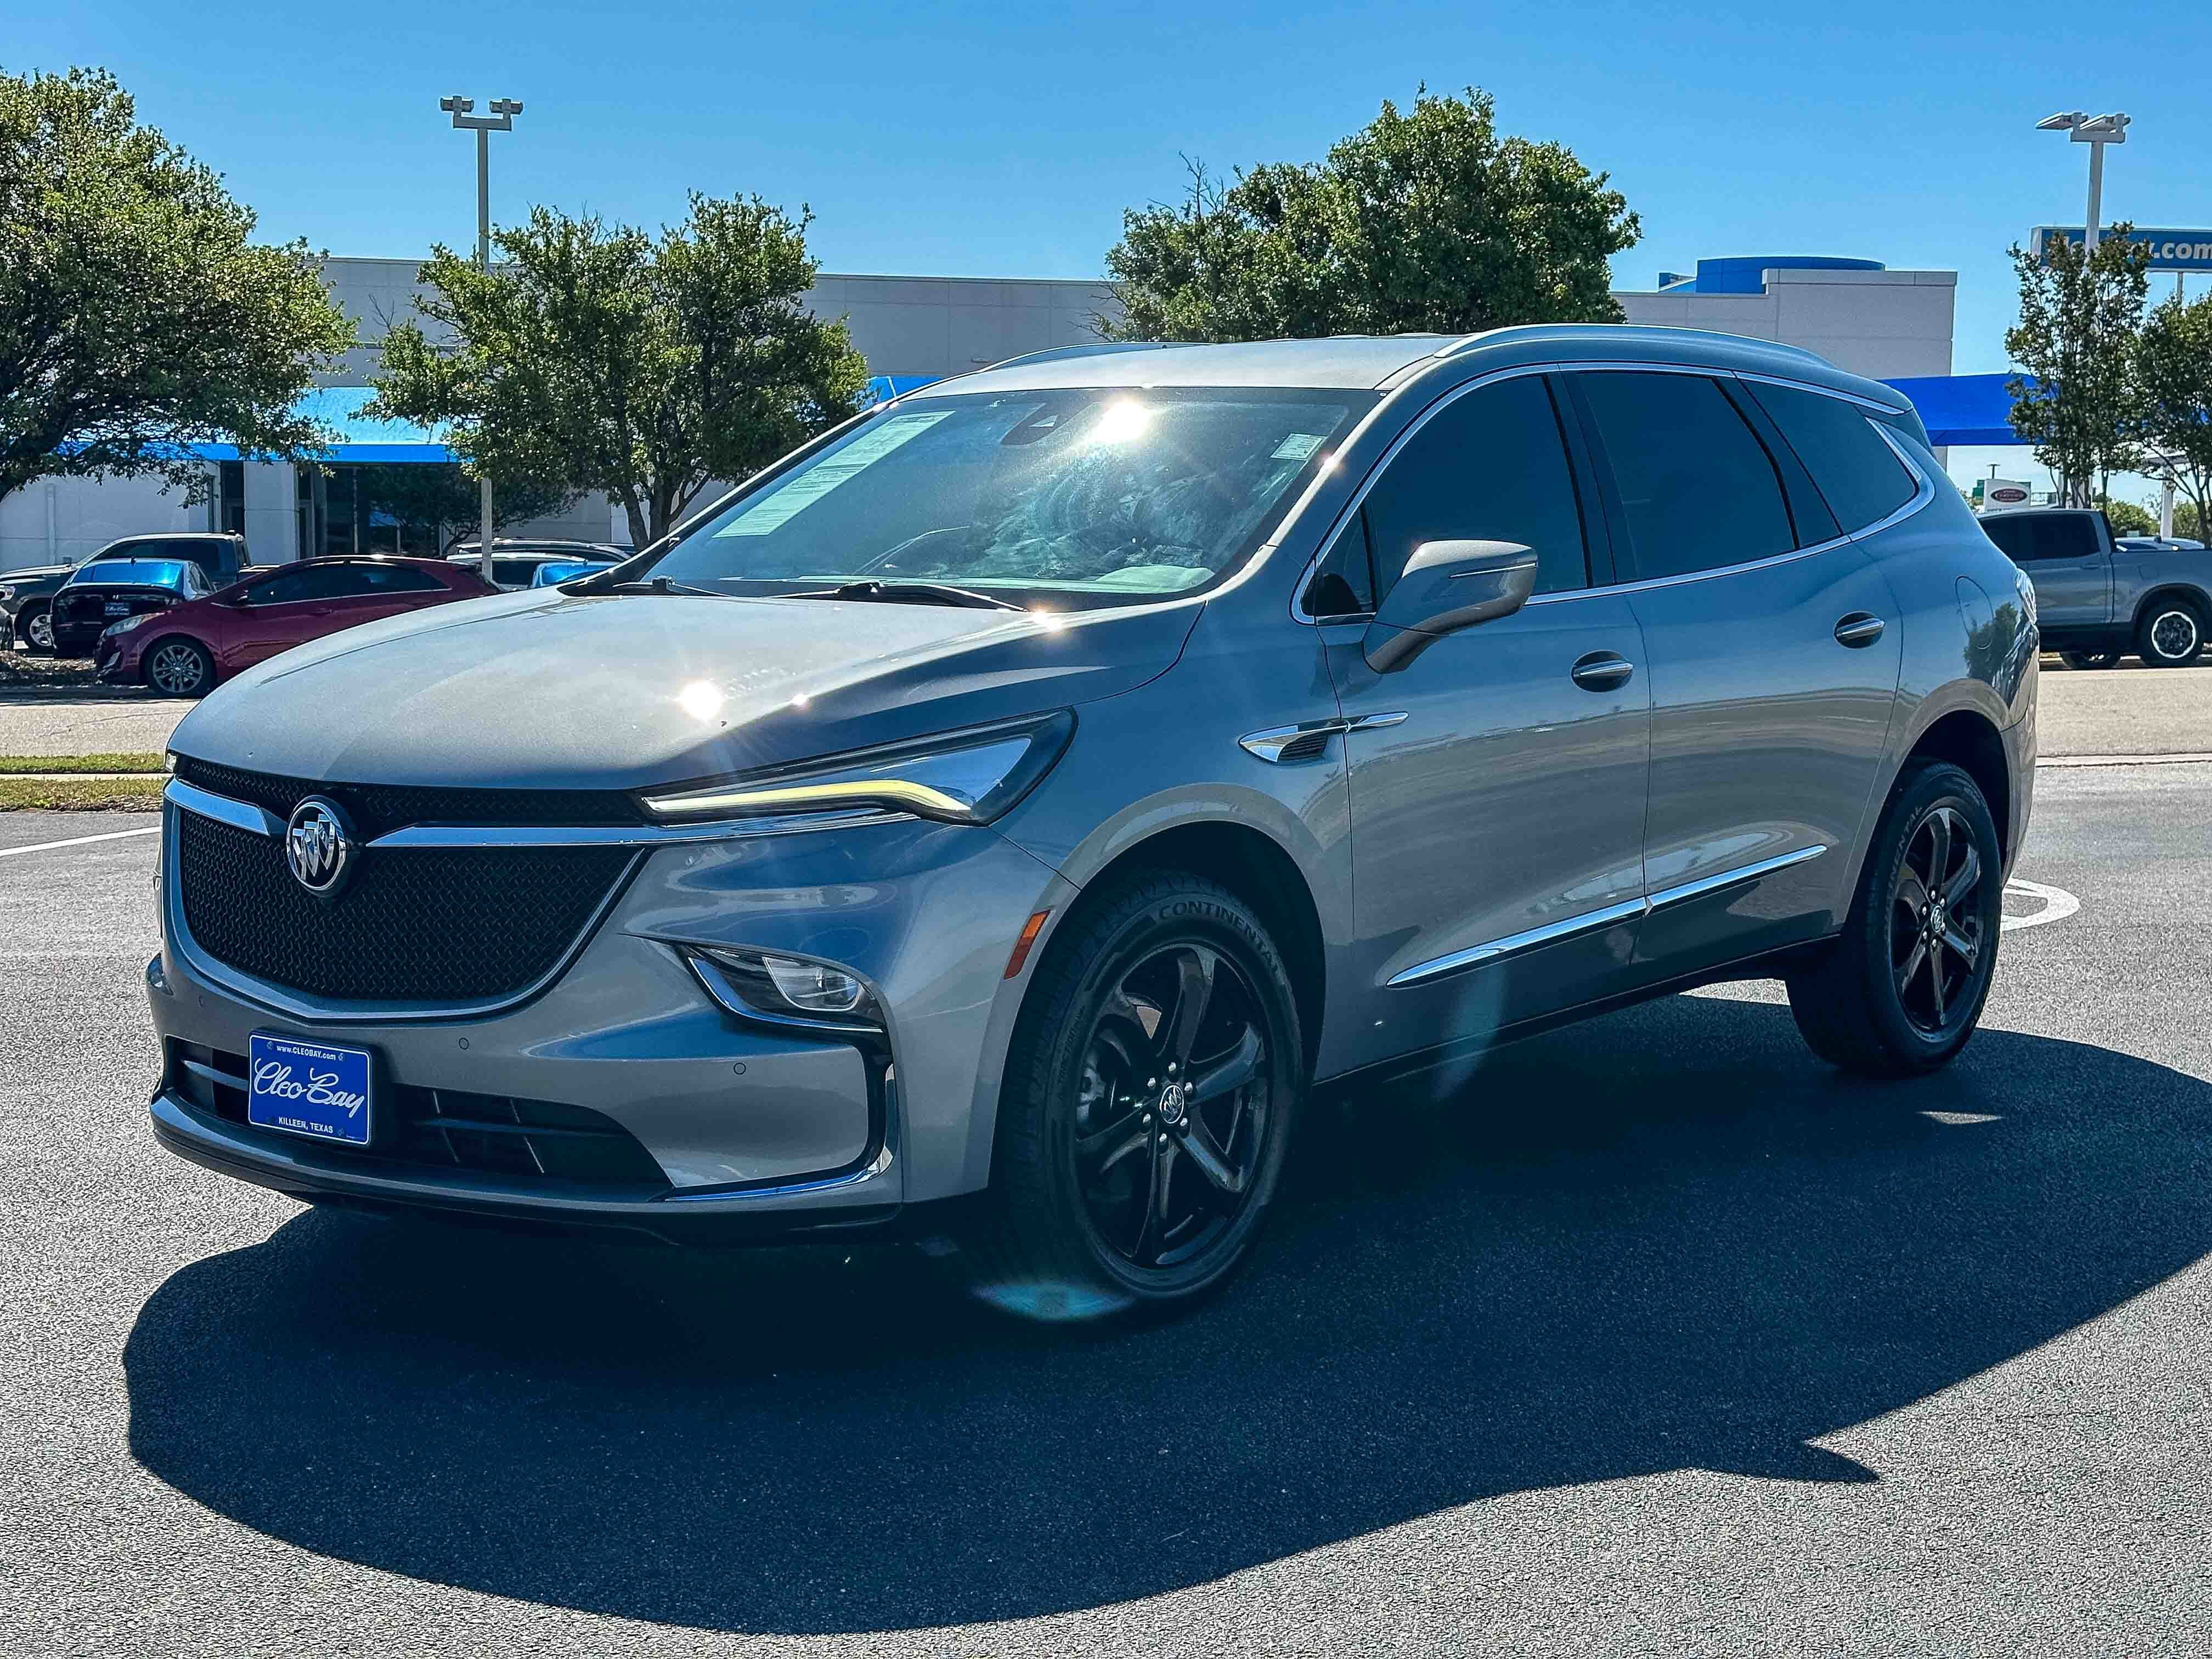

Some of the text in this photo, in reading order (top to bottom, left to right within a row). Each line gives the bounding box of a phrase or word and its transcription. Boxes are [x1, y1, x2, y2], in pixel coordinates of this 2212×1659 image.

[1159, 900, 1282, 979] CONTINENTAL
[276, 1045, 336, 1061] www.CLEOBAY.com
[253, 1058, 365, 1118] Cleo Bay
[278, 1116, 334, 1134] KILLEEN, TEXAS
